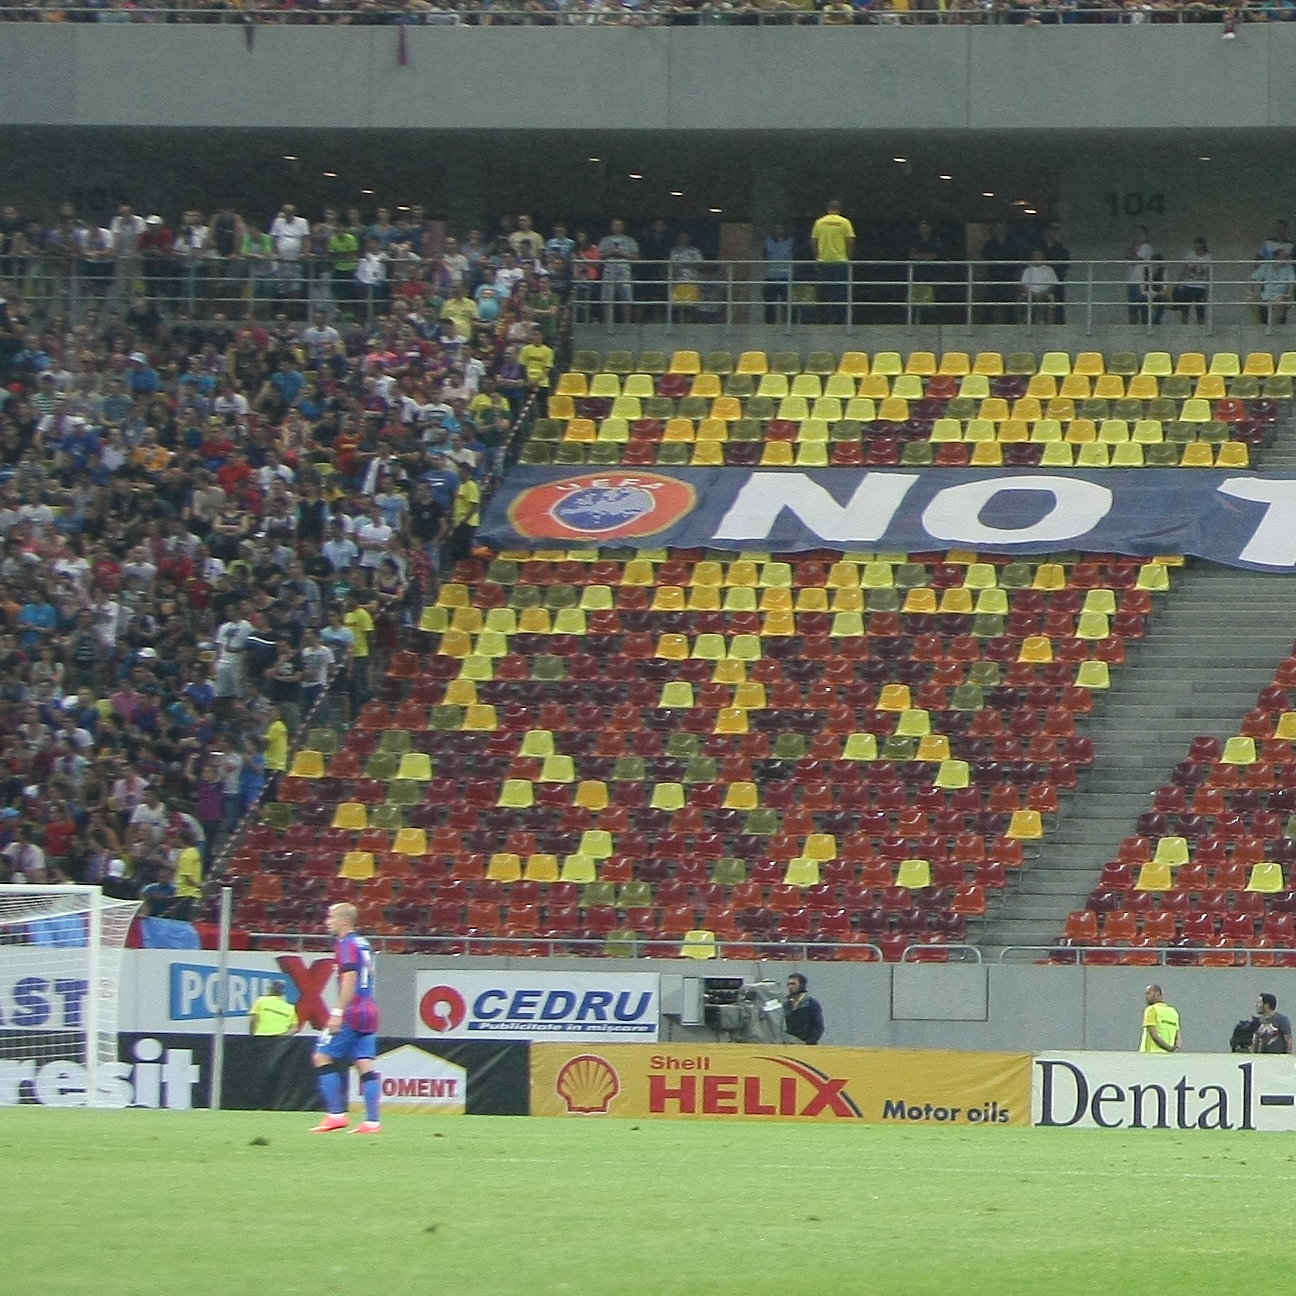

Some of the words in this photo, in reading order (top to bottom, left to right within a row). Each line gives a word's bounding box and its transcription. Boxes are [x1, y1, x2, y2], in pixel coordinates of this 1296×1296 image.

[1104, 191, 1166, 216] 104
[712, 472, 1113, 543] NO
[0, 977, 90, 1027] ST
[472, 989, 653, 1021] CEDRU
[649, 1055, 710, 1071] Shell
[360, 1078, 457, 1098] OMENT
[648, 1068, 858, 1119] HELIX
[882, 1100, 961, 1123] Motor
[966, 1101, 1010, 1124] oils
